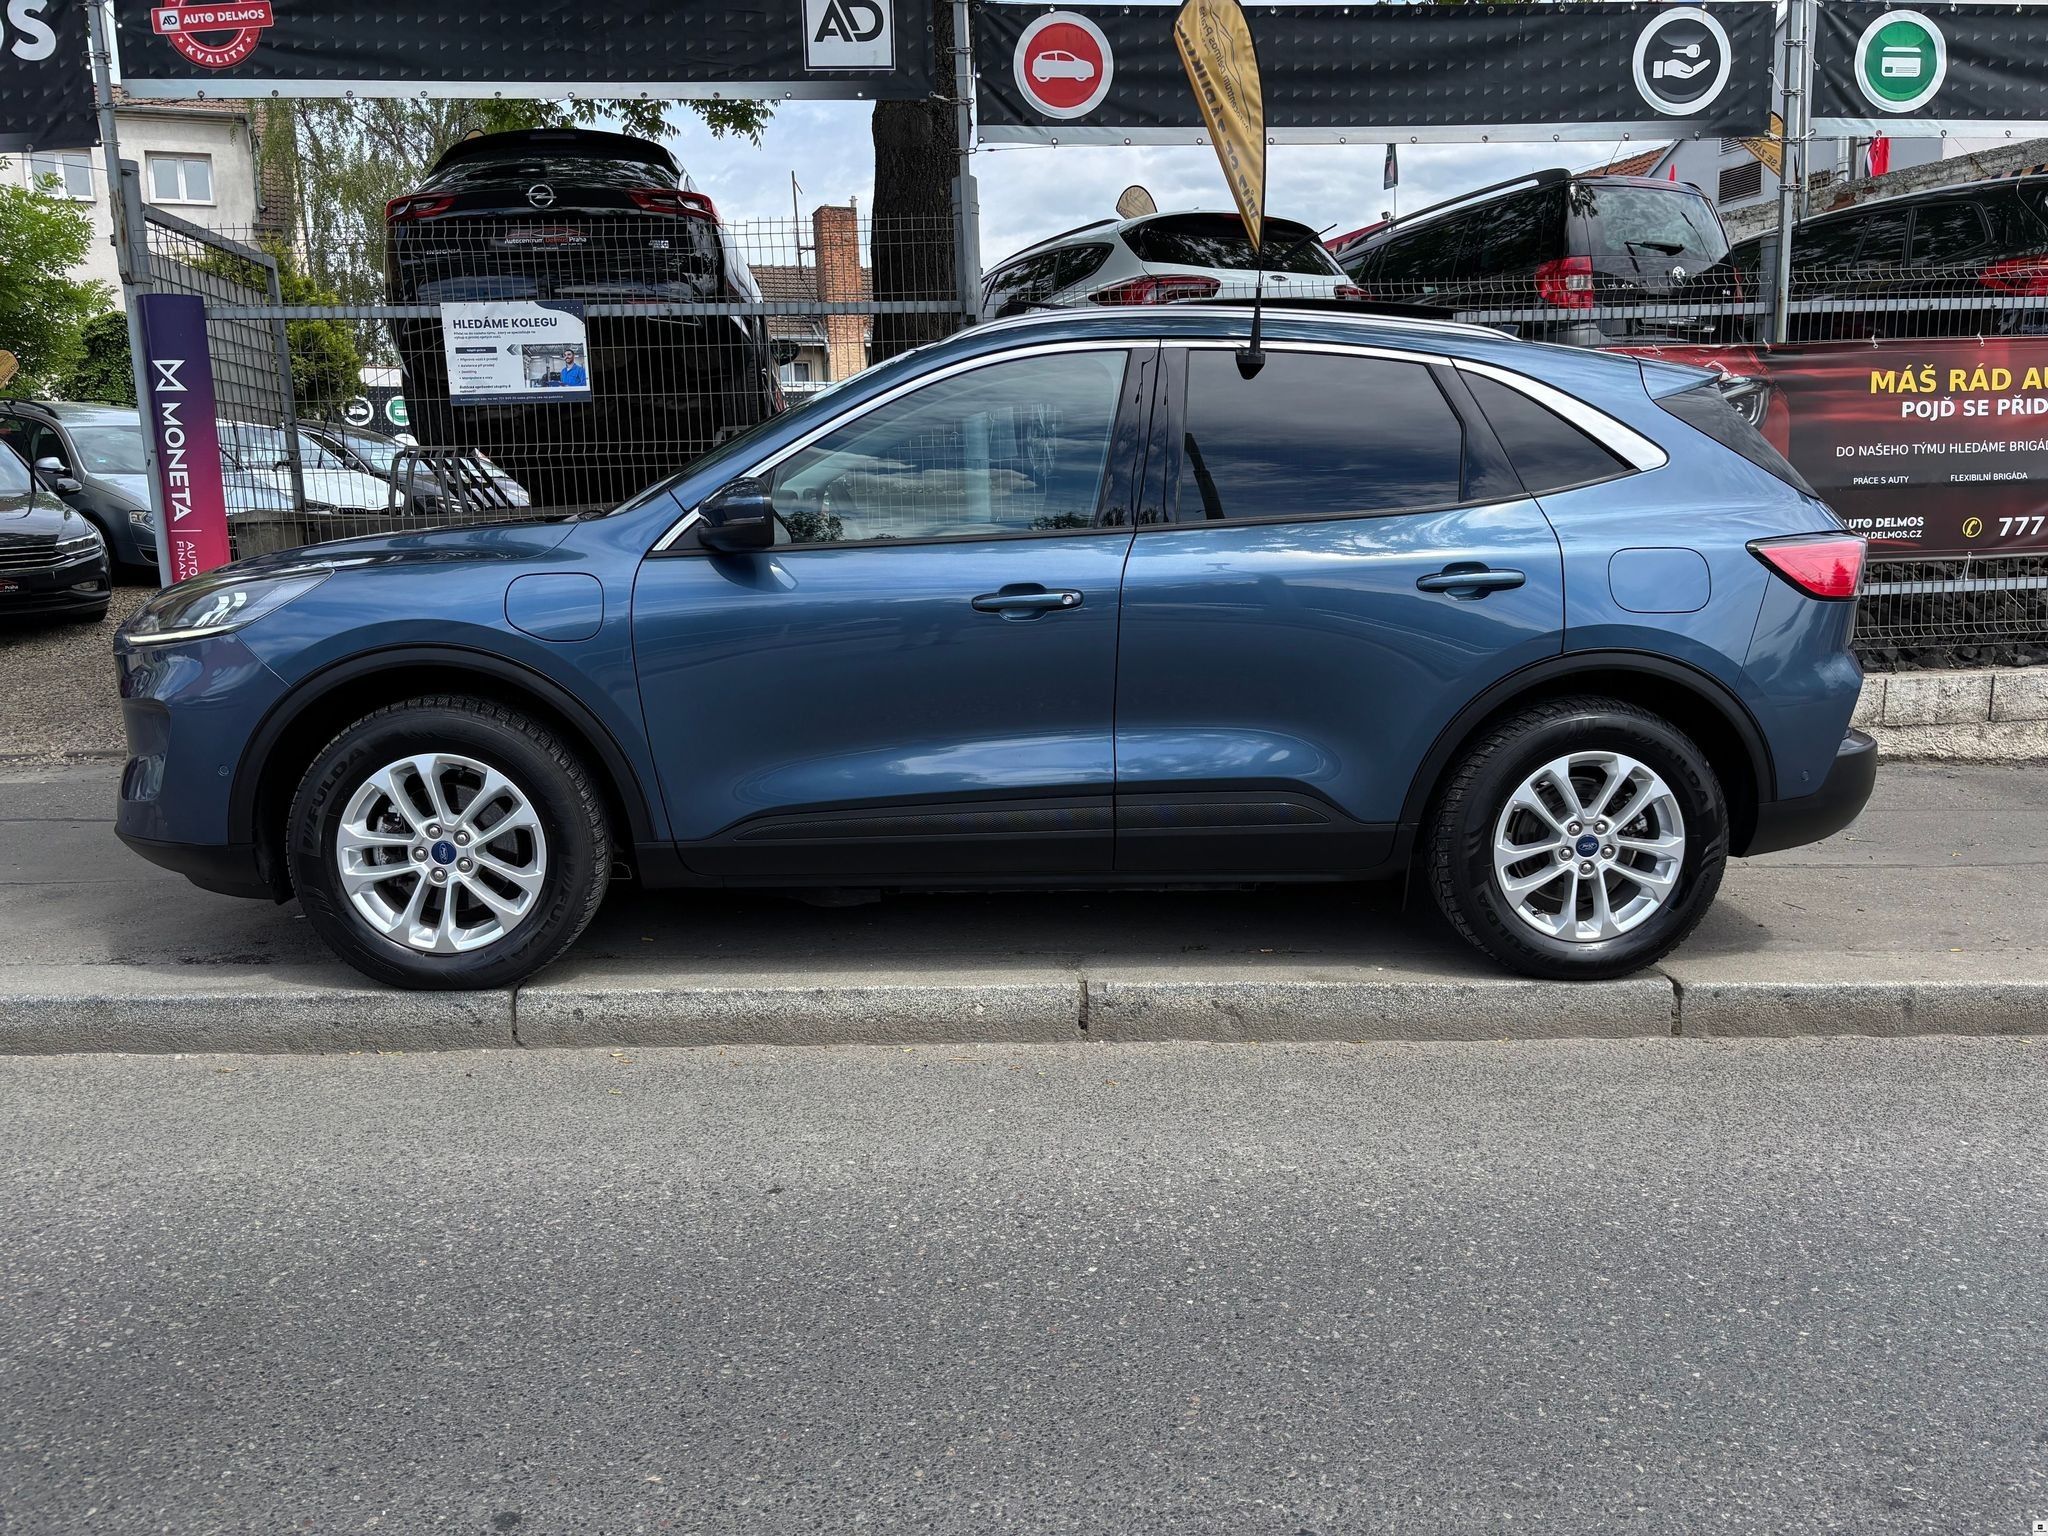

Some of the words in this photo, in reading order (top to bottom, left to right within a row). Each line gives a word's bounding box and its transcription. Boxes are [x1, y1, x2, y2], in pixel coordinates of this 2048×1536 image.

[183, 12, 215, 25] AUTO
[217, 9, 265, 22] DELMOS
[0, 0, 57, 61] S
[185, 43, 246, 64] KVALITY
[452, 316, 509, 330] HLEDÁME
[511, 317, 558, 329] KOLEGU
[1870, 363, 1937, 394] MÁŠ
[1949, 362, 2012, 392] RÁD
[2022, 366, 2048, 390] A
[1901, 396, 1956, 422] POJĎ
[1963, 399, 1989, 417] SE
[1997, 394, 2048, 416] PŘID
[1836, 446, 1855, 457] DO
[1858, 442, 1909, 456] NAŠEHO
[1912, 441, 1946, 455] TÝMU
[1949, 439, 2006, 454] HLEDÁME
[161, 402, 193, 522] MONETA
[1853, 475, 1879, 485] PRÁCE
[1880, 476, 1887, 484] S
[1888, 475, 1909, 484] AUTY
[1950, 471, 1992, 482] FLEXIBILNÍ
[1993, 470, 2028, 481] BRIGÁDA
[1844, 518, 1873, 529] UTO
[1875, 516, 1924, 528] DELMOS
[1998, 515, 2046, 537] 777
[186, 541, 198, 576] AUTO
